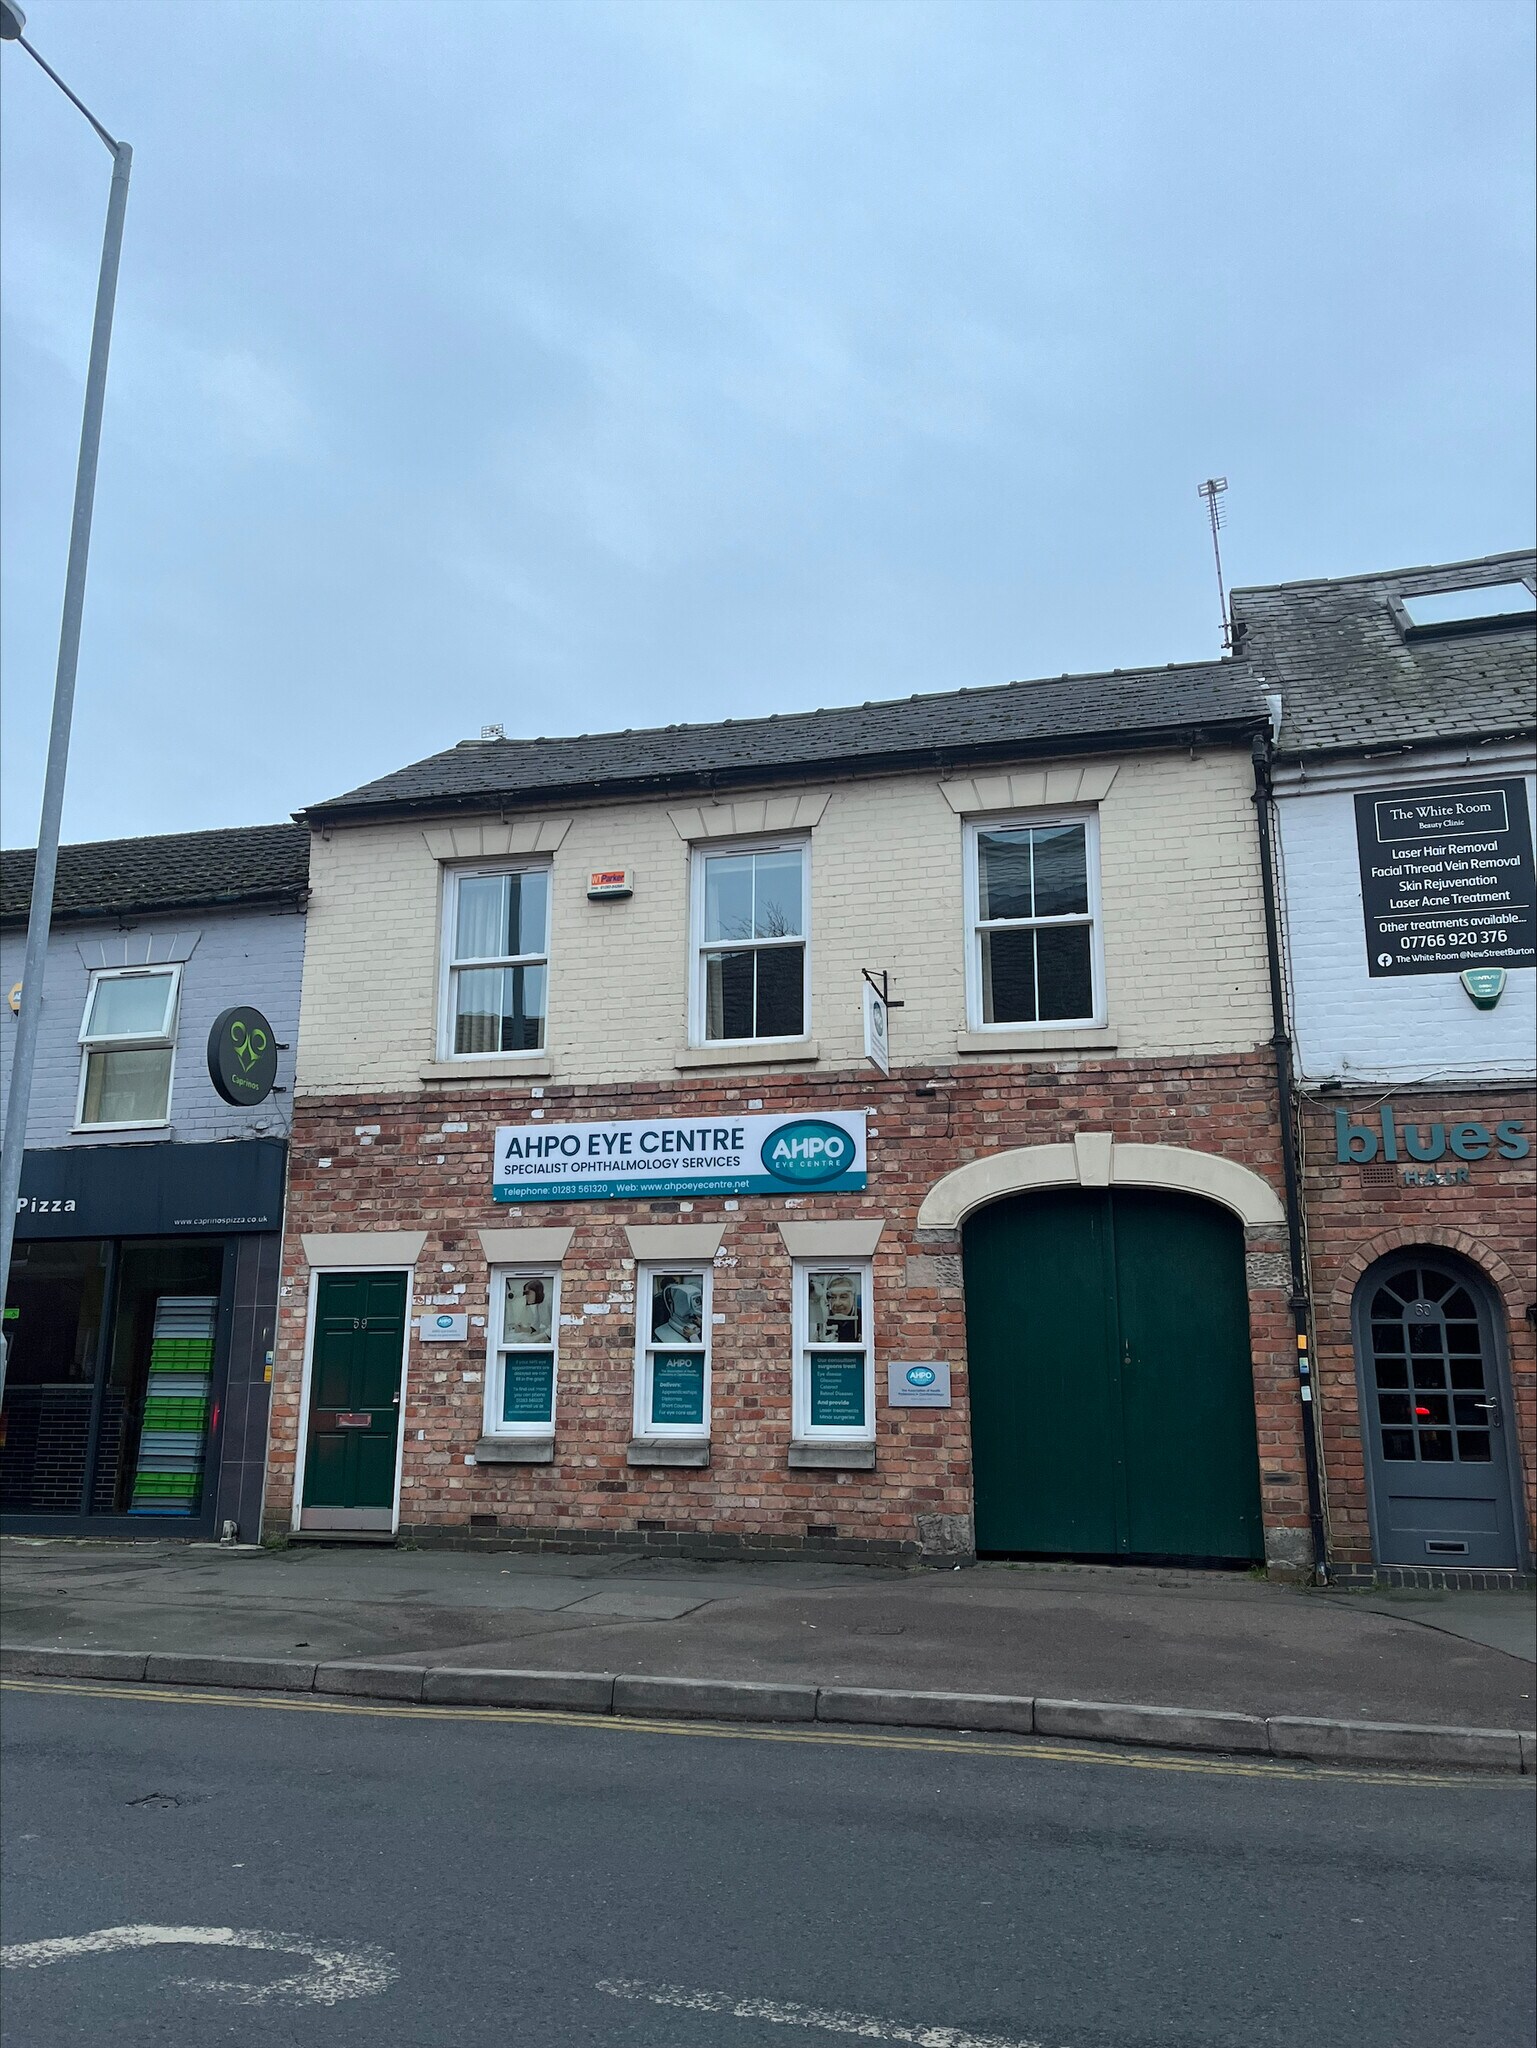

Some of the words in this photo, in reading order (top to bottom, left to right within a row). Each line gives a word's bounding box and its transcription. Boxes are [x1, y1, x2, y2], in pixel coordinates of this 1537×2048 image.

[1390, 808, 1414, 820] The
[1416, 805, 1454, 818] White
[1456, 802, 1492, 814] Room
[1418, 822, 1442, 830] Beauty
[1392, 848, 1422, 860] Laser
[1424, 845, 1446, 856] Hair
[1448, 840, 1498, 855] Removal
[1371, 865, 1402, 878] Facial
[1404, 862, 1443, 875] Thread
[1444, 860, 1469, 872] Vein
[1470, 855, 1520, 869] Removal
[1399, 880, 1422, 892] Skin
[1424, 874, 1498, 891] Rejuvenation
[1390, 898, 1420, 909] Laser
[1422, 895, 1450, 906] Acne
[1451, 890, 1511, 904] Treatment
[1379, 921, 1408, 933] Other
[1410, 917, 1469, 930] treatments
[1400, 934, 1446, 949] 07766
[1448, 932, 1478, 946] 920
[1480, 930, 1508, 943] 376
[1396, 955, 1411, 963] The
[1412, 953, 1434, 962] White
[1436, 951, 1459, 960] Room
[1460, 947, 1535, 960] @NewStreetBurton
[232, 1074, 259, 1090] Caprinos
[1335, 1104, 1530, 1164] blues
[505, 1134, 580, 1159] AHPO
[588, 1132, 632, 1156] EYE
[640, 1128, 744, 1154] CENTRE
[772, 1136, 844, 1160] AHPO
[504, 1162, 568, 1175] SPECIALIST
[571, 1158, 679, 1173] OPHTHALMOLOGY
[682, 1156, 740, 1168] SERVICES
[1404, 1167, 1470, 1186] HAIR
[504, 1187, 550, 1197] Telephone:
[552, 1185, 576, 1194] 01283
[578, 1184, 608, 1193] 561320
[616, 1184, 639, 1192] Web:
[640, 1180, 750, 1192] www.ahpoeyecentre.net
[16, 1197, 76, 1213] Pizza
[354, 1317, 368, 1329] 59
[666, 1359, 692, 1367] AHPO
